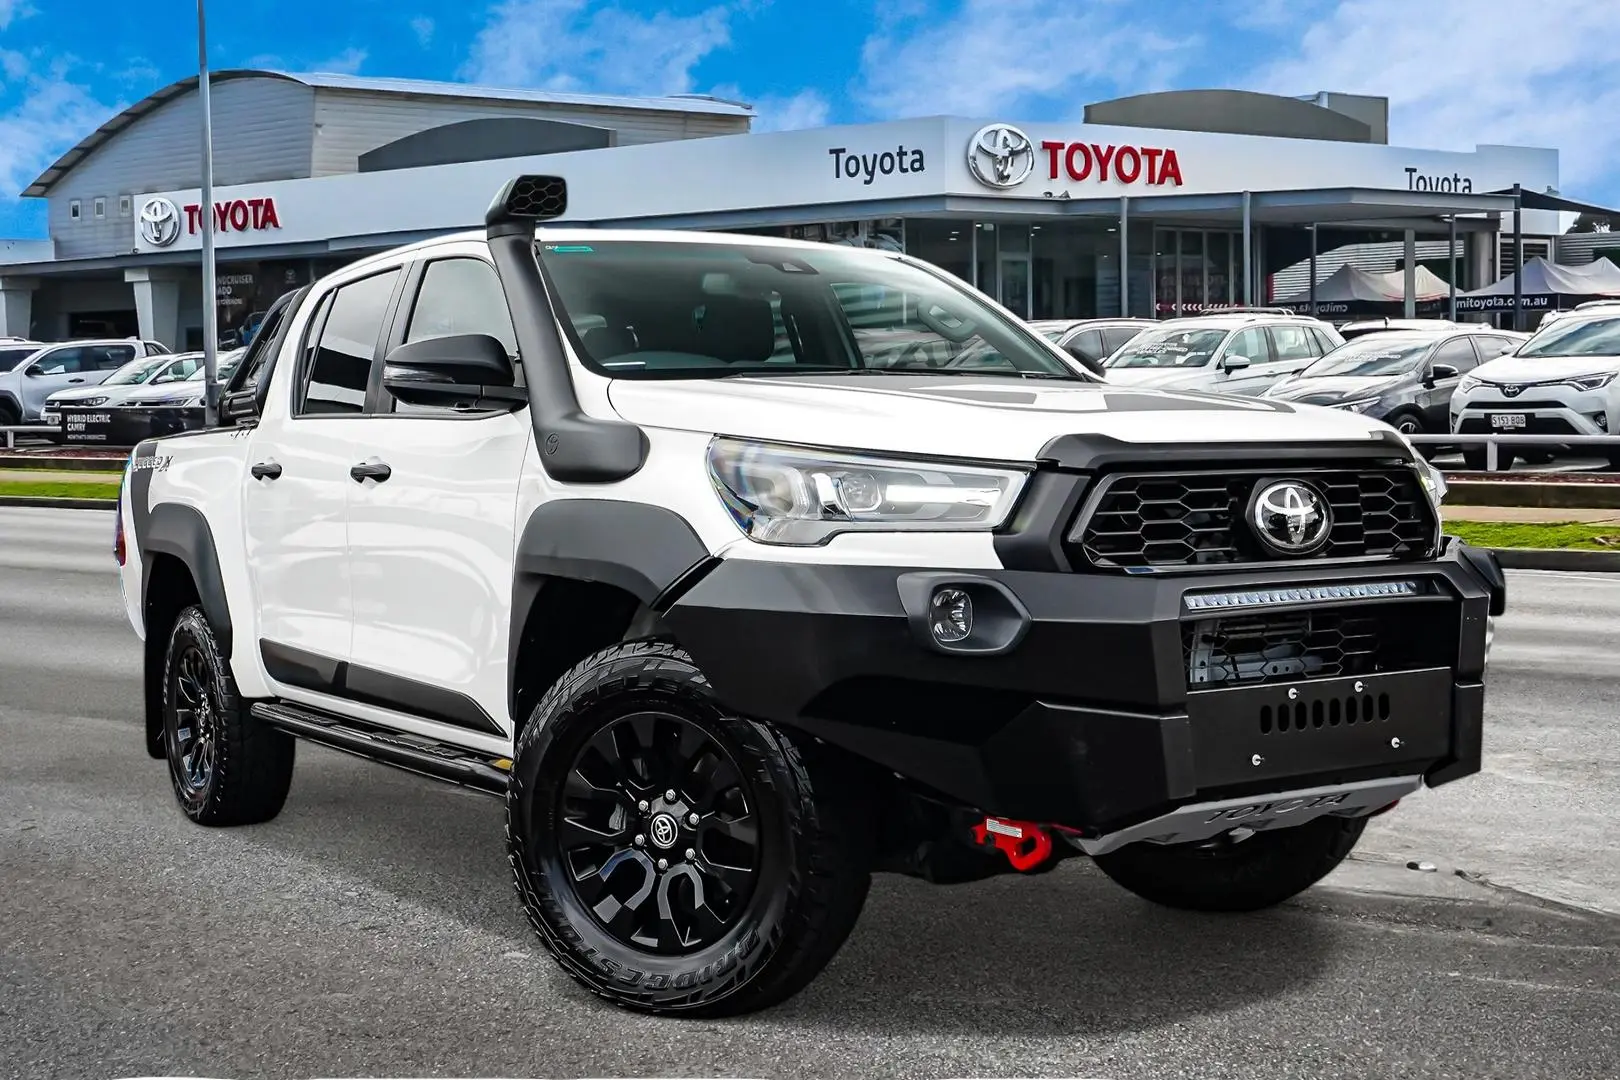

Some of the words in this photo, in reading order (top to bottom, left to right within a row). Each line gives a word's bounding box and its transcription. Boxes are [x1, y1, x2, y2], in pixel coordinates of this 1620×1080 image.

[828, 145, 925, 185] Toyota
[1041, 140, 1183, 186] TOYOTA
[67, 414, 86, 423] HYBRID
[86, 414, 111, 423] ELECTRIC
[67, 423, 86, 431] CAMRY
[1204, 793, 1351, 824] TOYOTA
